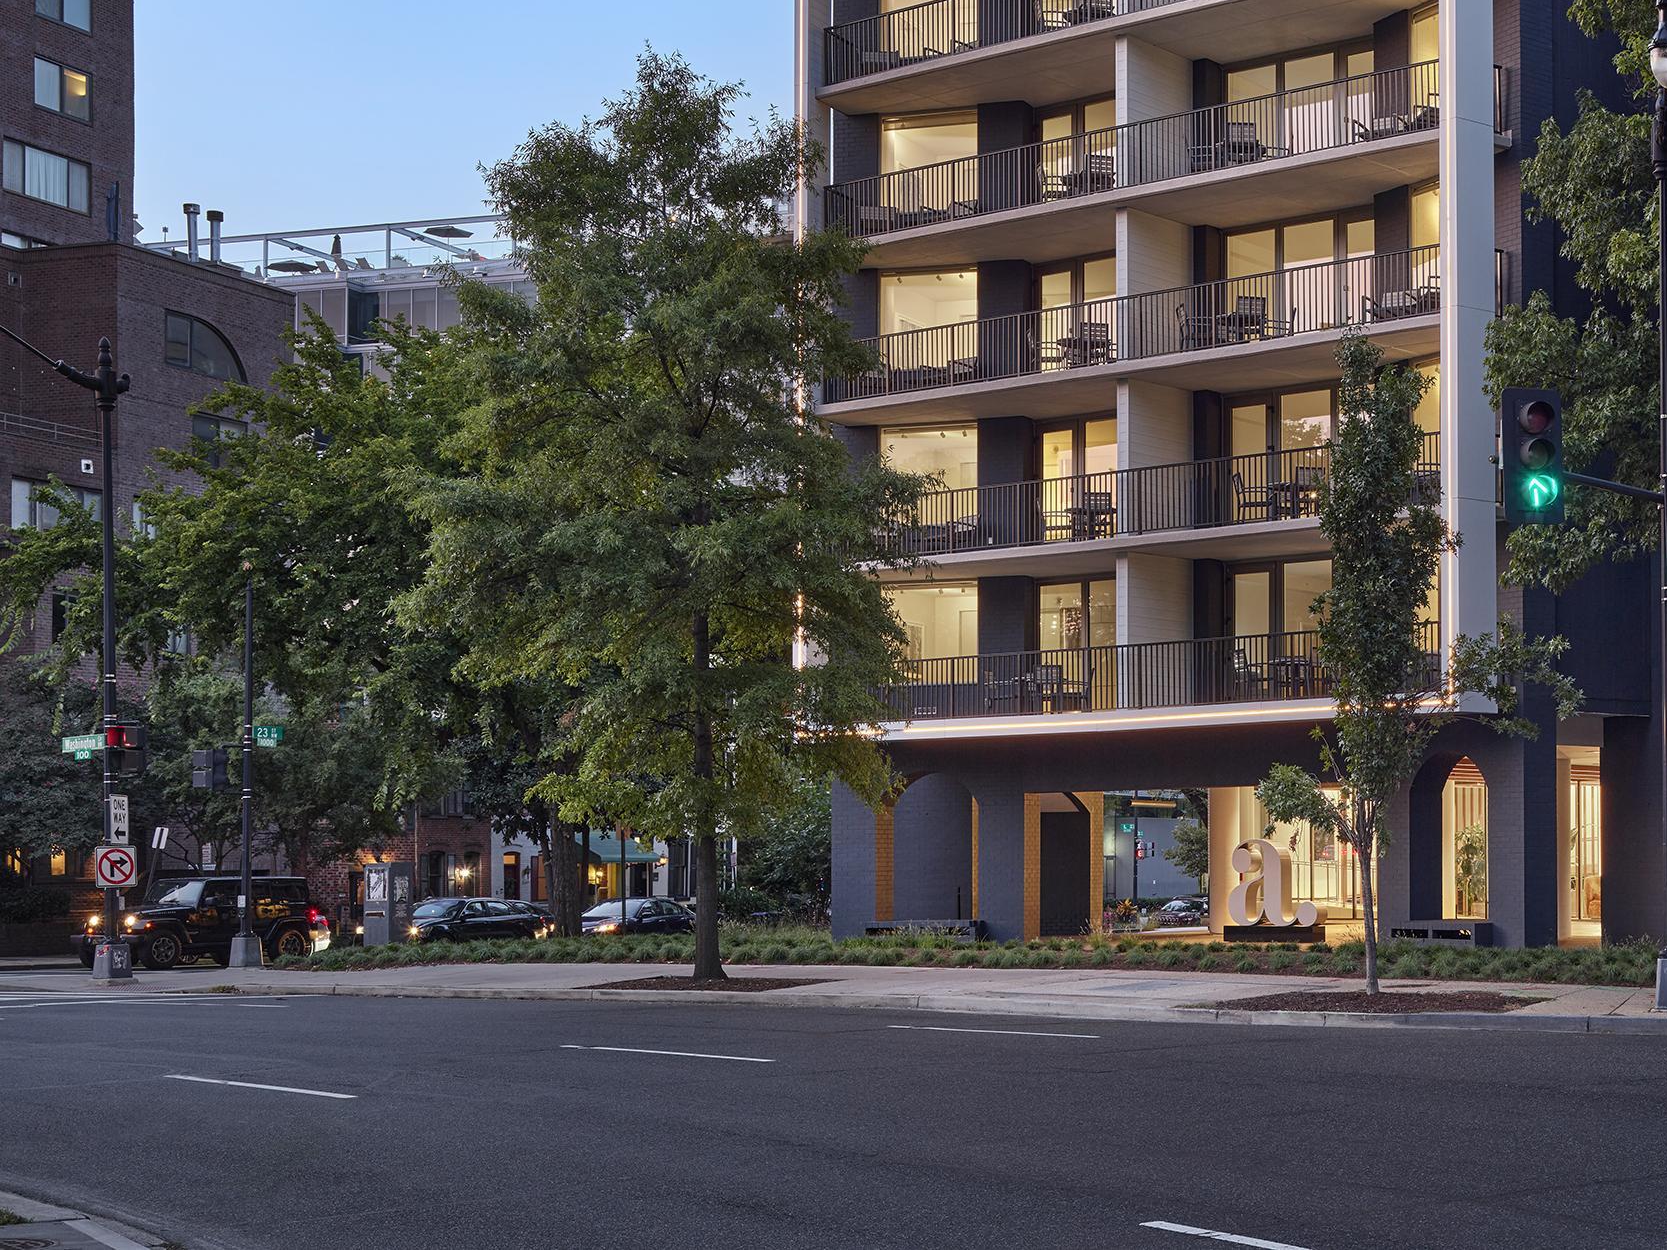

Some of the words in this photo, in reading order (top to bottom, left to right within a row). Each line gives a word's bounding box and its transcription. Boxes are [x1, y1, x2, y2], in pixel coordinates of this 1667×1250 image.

[257, 727, 268, 738] 23
[76, 750, 90, 760] 100
[113, 799, 126, 811] ONE
[113, 812, 126, 824] WAY
